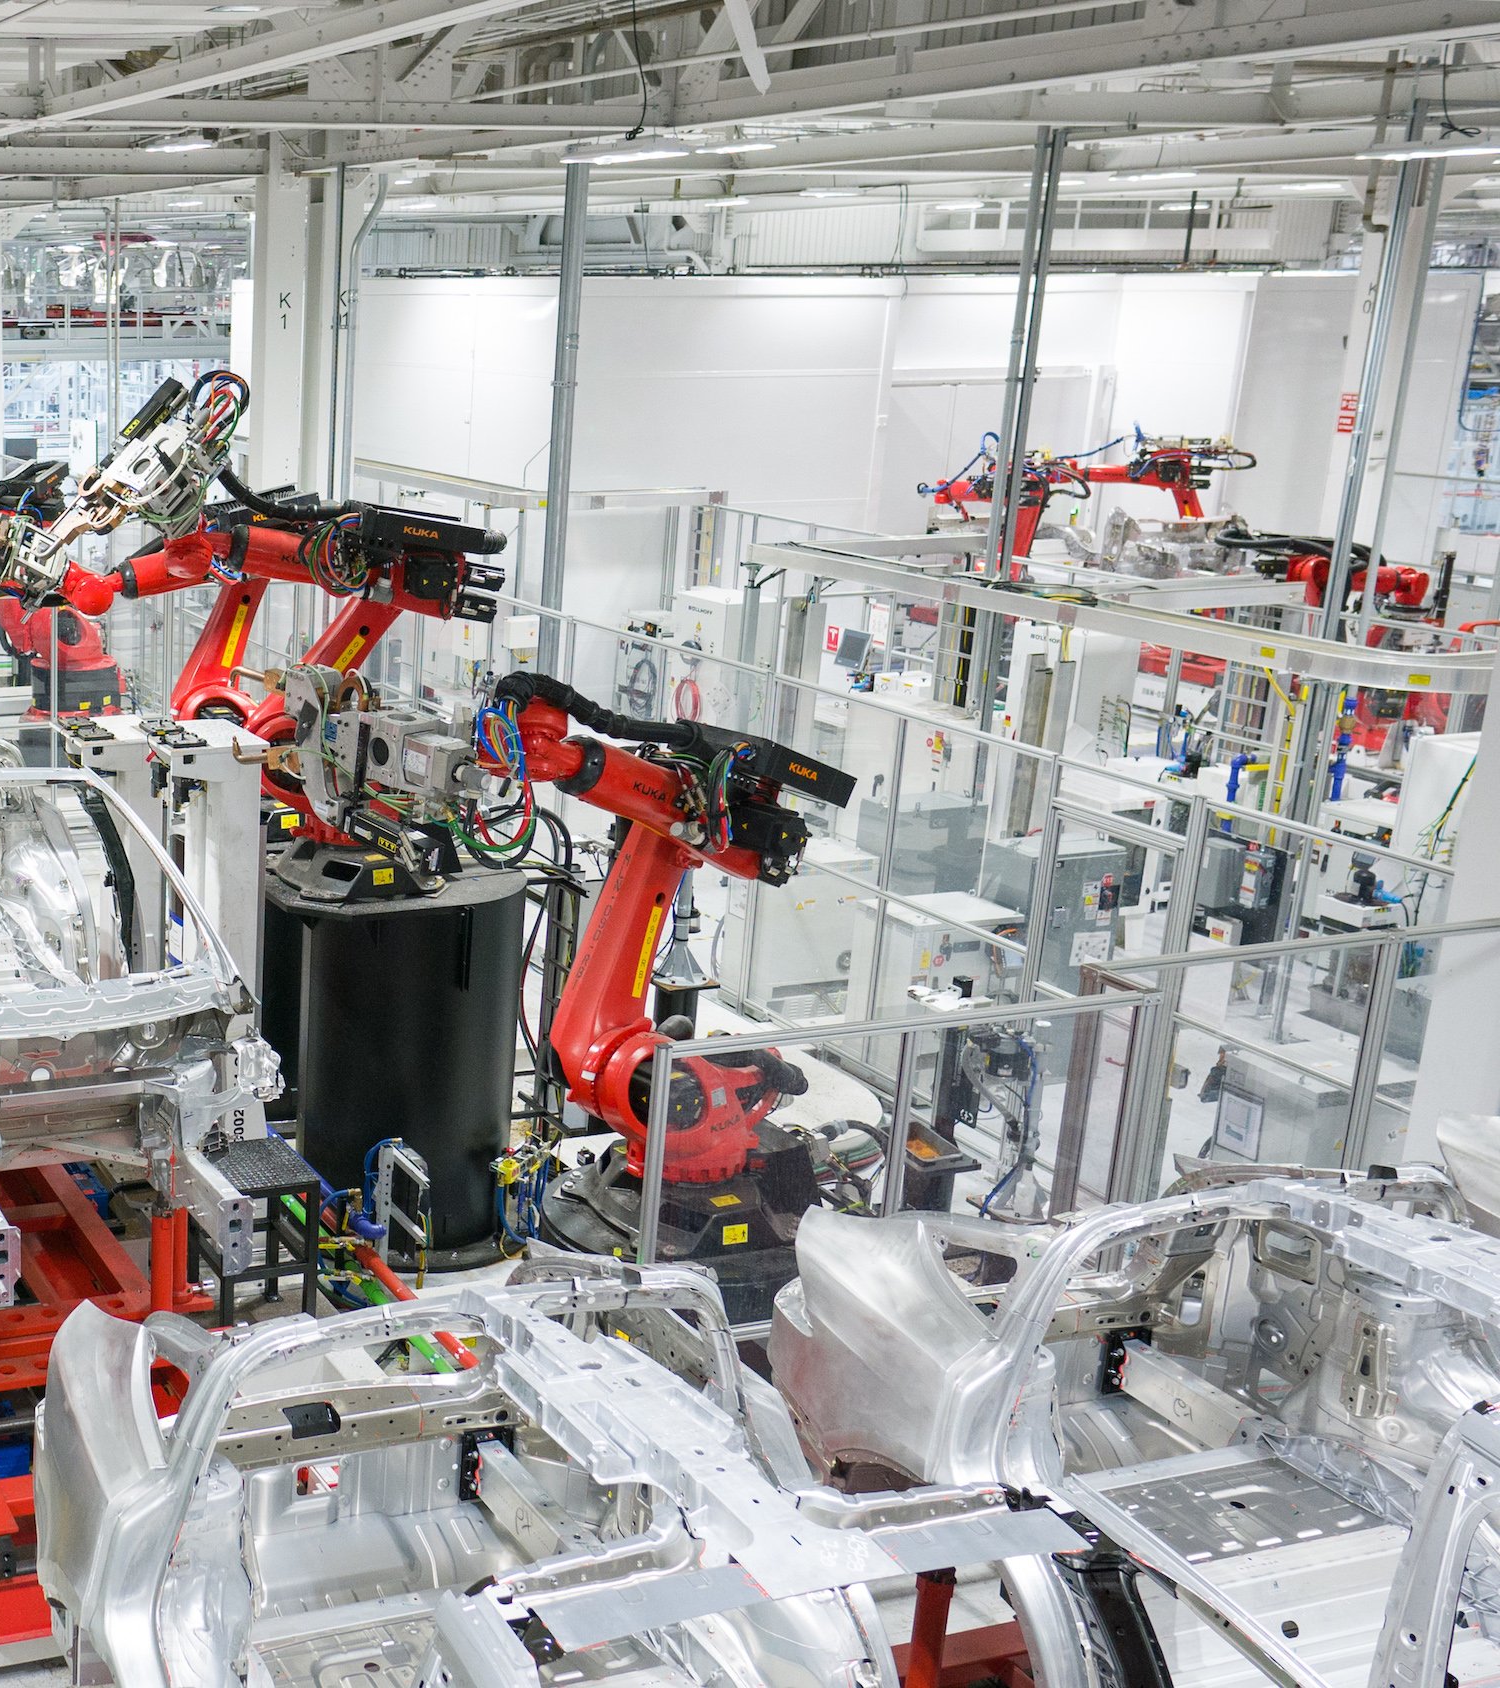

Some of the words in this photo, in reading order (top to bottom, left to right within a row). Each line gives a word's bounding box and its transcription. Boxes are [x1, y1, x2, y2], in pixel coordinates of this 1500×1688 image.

[280, 292, 292, 309] K
[281, 313, 288, 330] 1
[403, 524, 440, 541] KUKA
[789, 761, 818, 781] KUKA
[633, 781, 666, 803] KUKA
